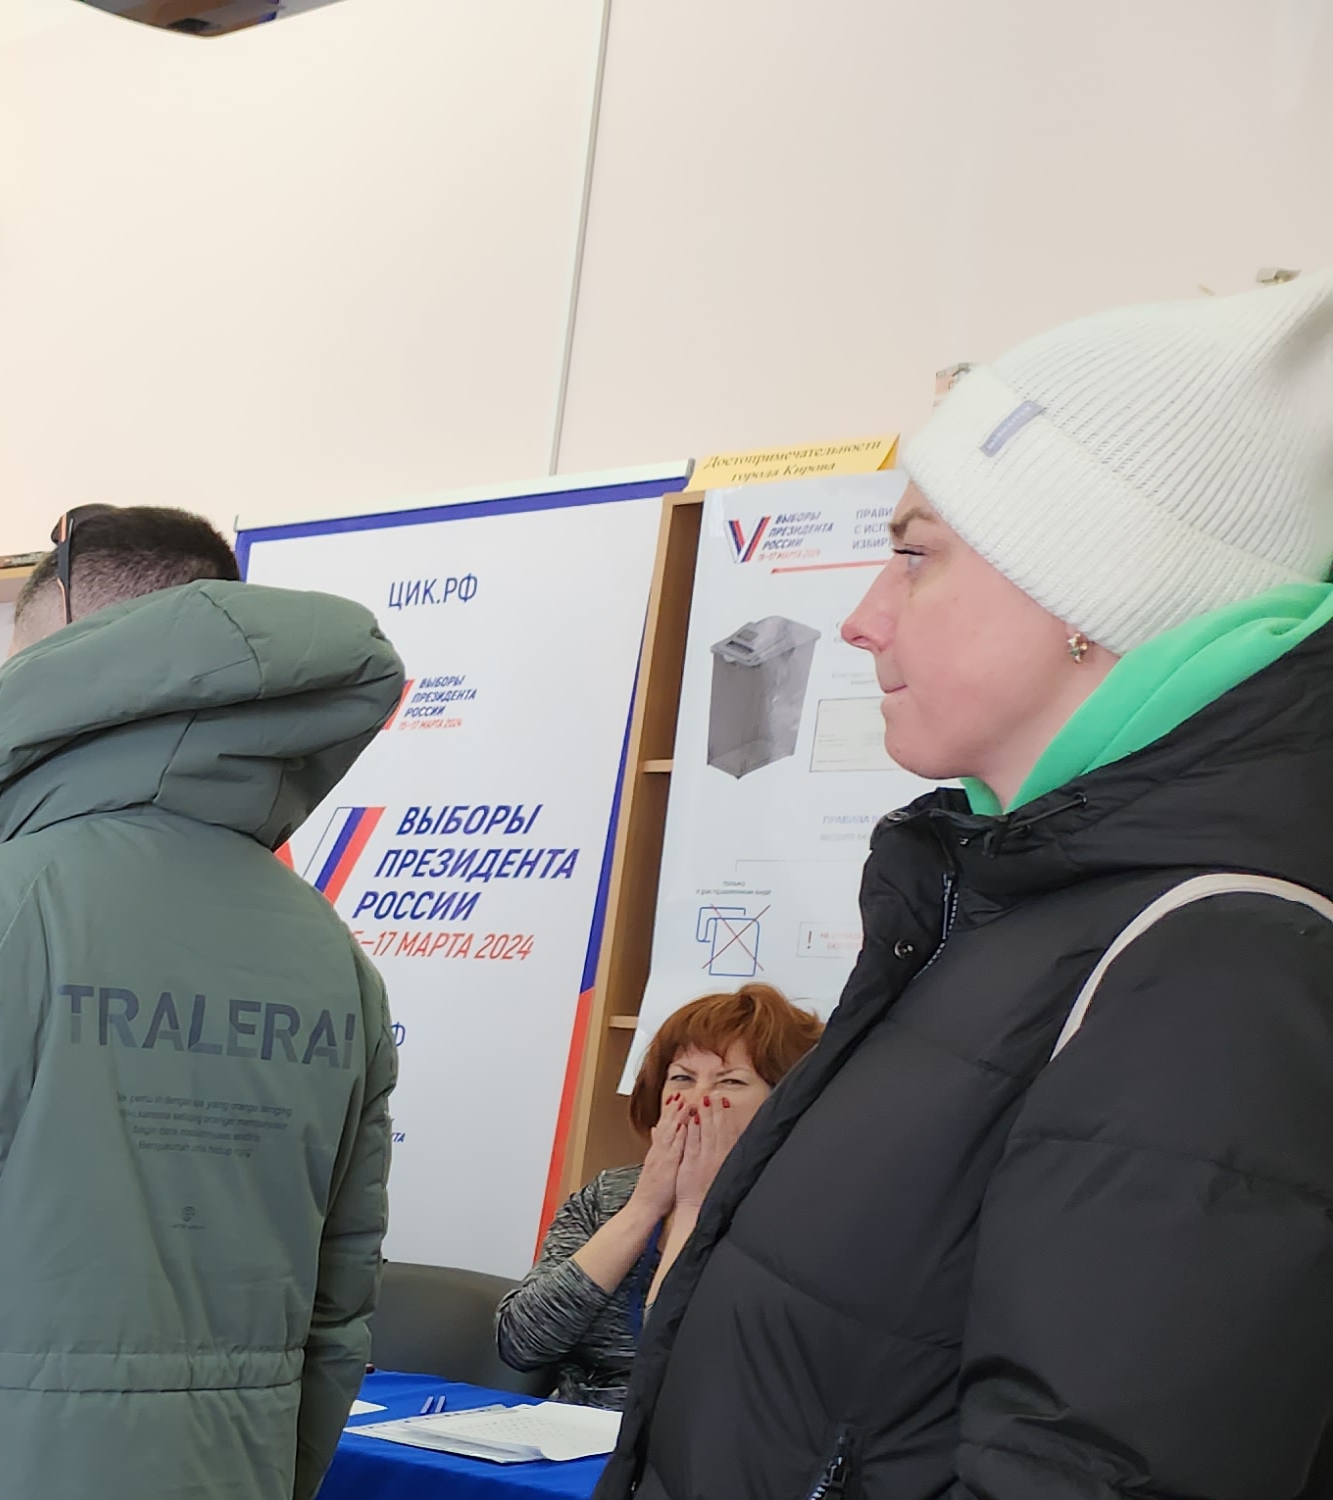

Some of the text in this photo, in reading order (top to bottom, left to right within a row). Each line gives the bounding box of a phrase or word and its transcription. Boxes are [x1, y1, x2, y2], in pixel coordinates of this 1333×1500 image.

[732, 468, 779, 483] города
[775, 511, 822, 525] ВЫБОРЫ
[768, 522, 834, 538] ПРЕЗИДЕНТА
[762, 537, 803, 550] РОССИИ
[388, 573, 478, 611] ЦИК.РФ
[419, 675, 466, 689] ВЫБОРЫ
[411, 689, 477, 703] ПРЕЗИДЕНТА
[404, 706, 446, 718] РОССИИ
[395, 804, 543, 836] ВЫБОРЫ
[374, 848, 581, 883] ПРЕЗИДЕНТА
[352, 891, 482, 921] РОССИИ
[394, 932, 477, 960] МАРТА
[474, 934, 535, 961] 2024
[57, 983, 357, 1071] TRALERAI
